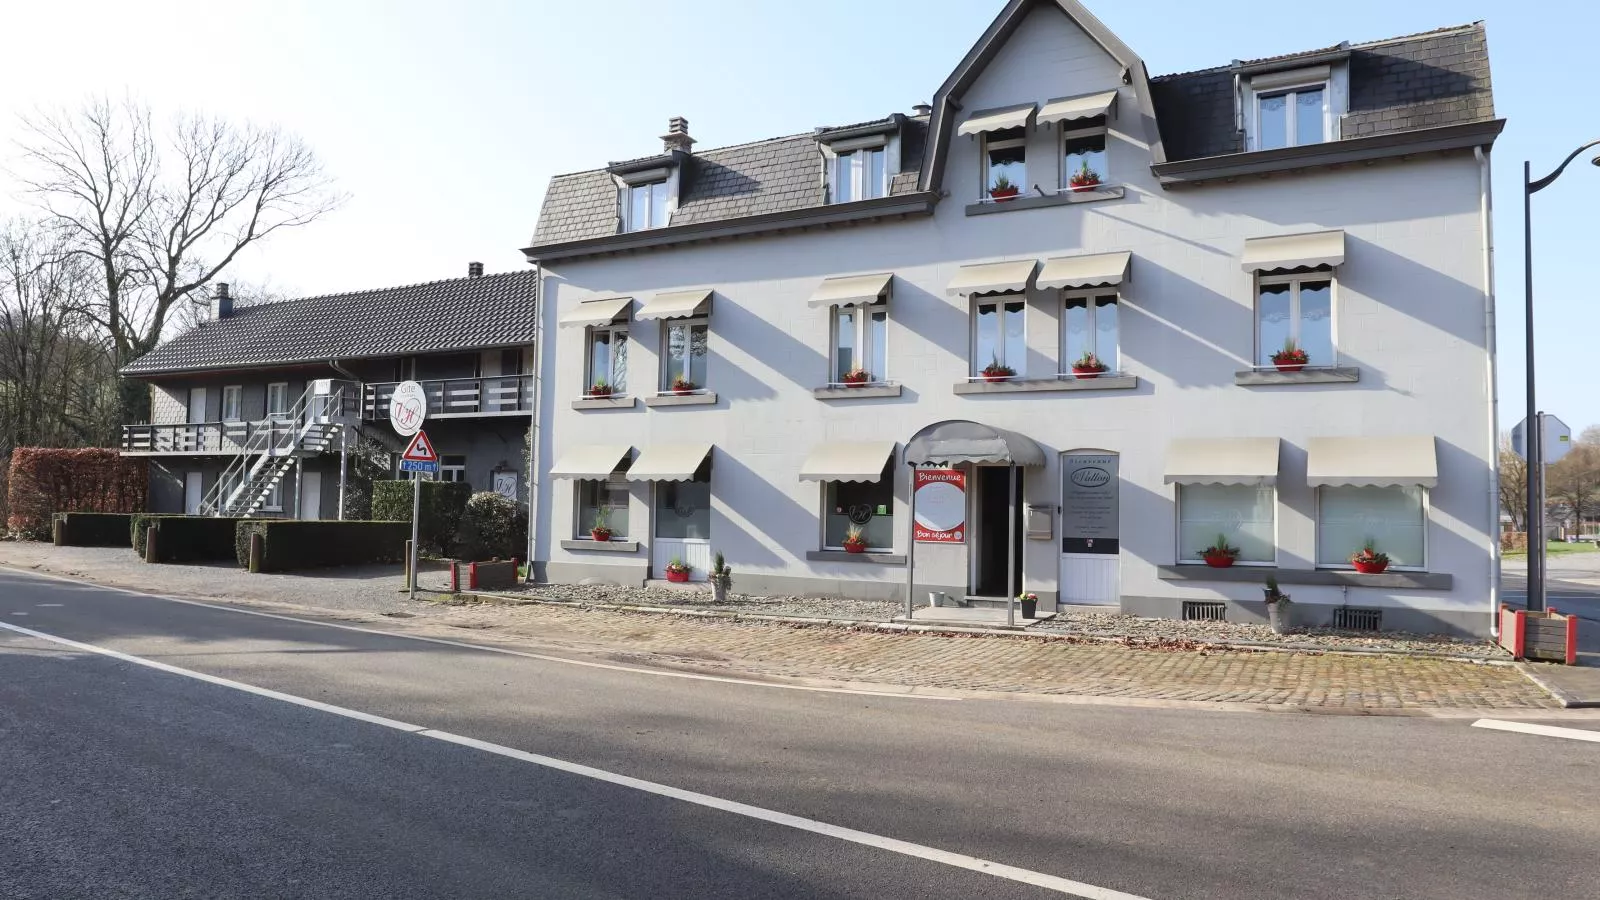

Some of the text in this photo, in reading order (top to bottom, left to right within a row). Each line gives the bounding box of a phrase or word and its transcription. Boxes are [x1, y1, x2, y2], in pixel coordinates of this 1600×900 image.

[408, 462, 422, 470] 250
[919, 472, 961, 481] Bienvenue
[917, 530, 951, 540] Bon séjour
